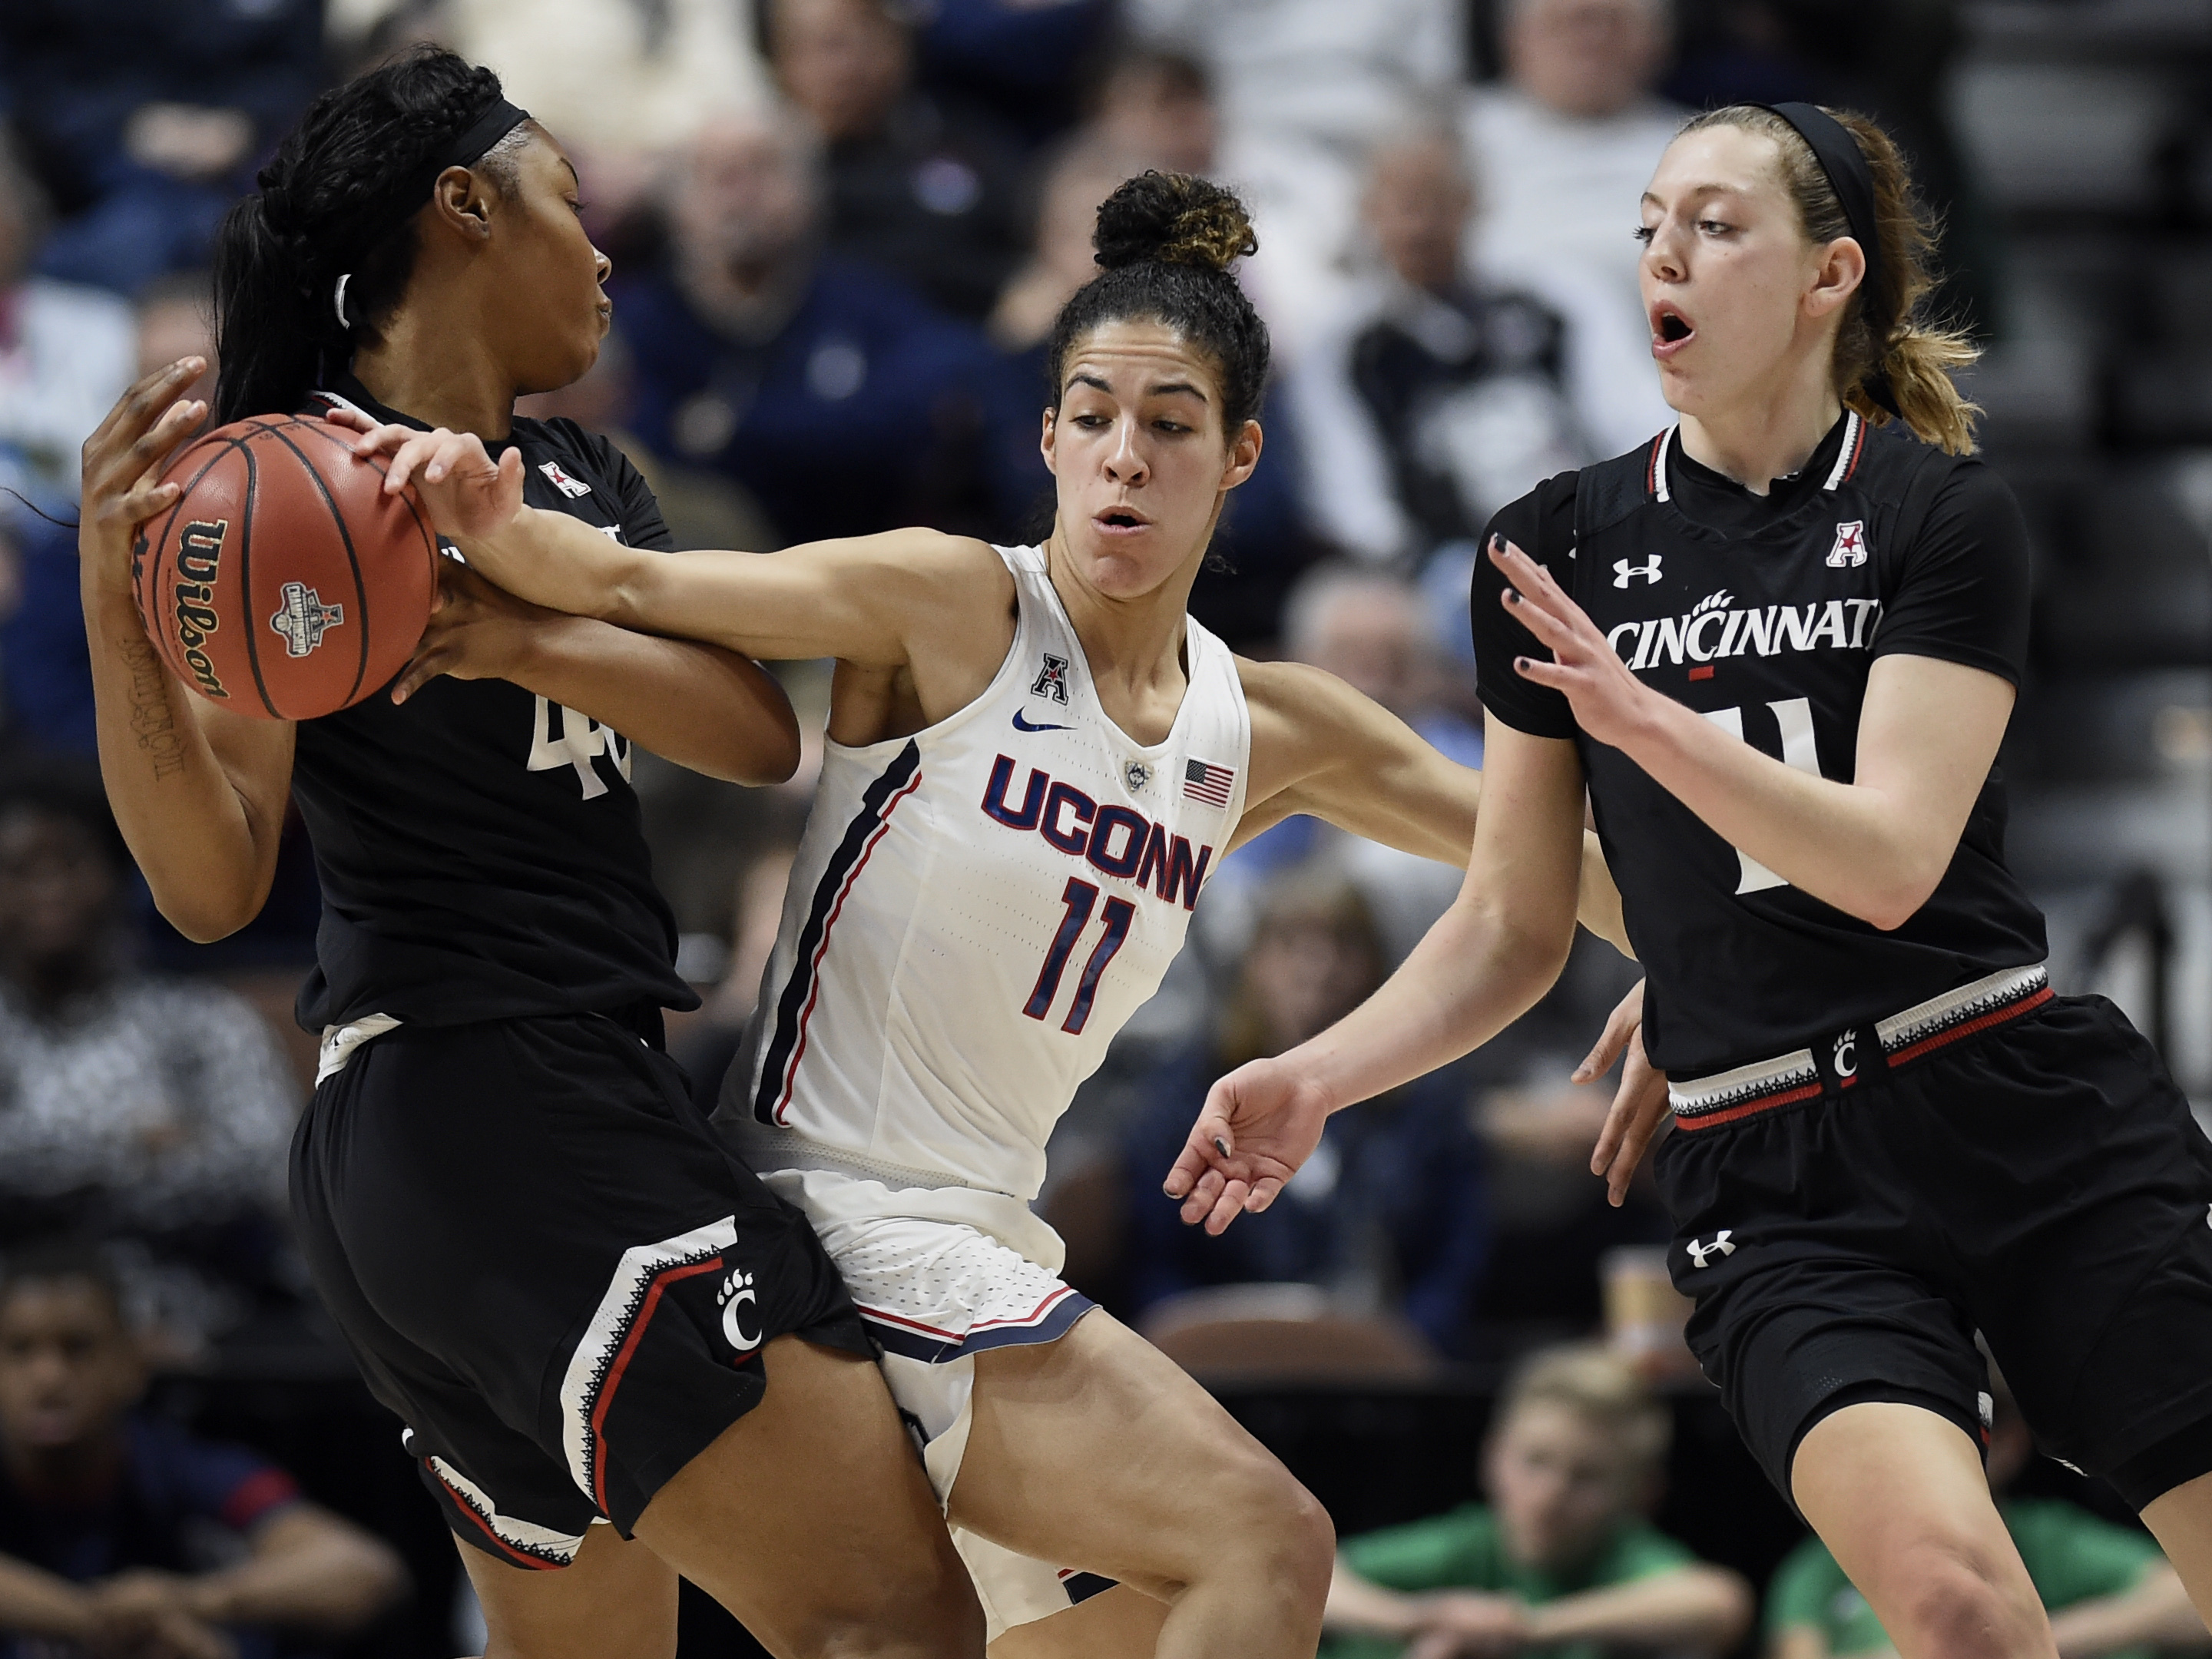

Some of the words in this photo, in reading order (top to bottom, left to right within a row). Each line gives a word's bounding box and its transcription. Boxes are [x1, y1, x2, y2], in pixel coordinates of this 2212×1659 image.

[1826, 521, 1867, 567] A
[174, 519, 231, 698] Wilson
[286, 586, 306, 654] CHAMPIONSHIP
[1031, 653, 1068, 705] A
[981, 753, 1212, 911] UCONN
[1022, 876, 1136, 1035] 11
